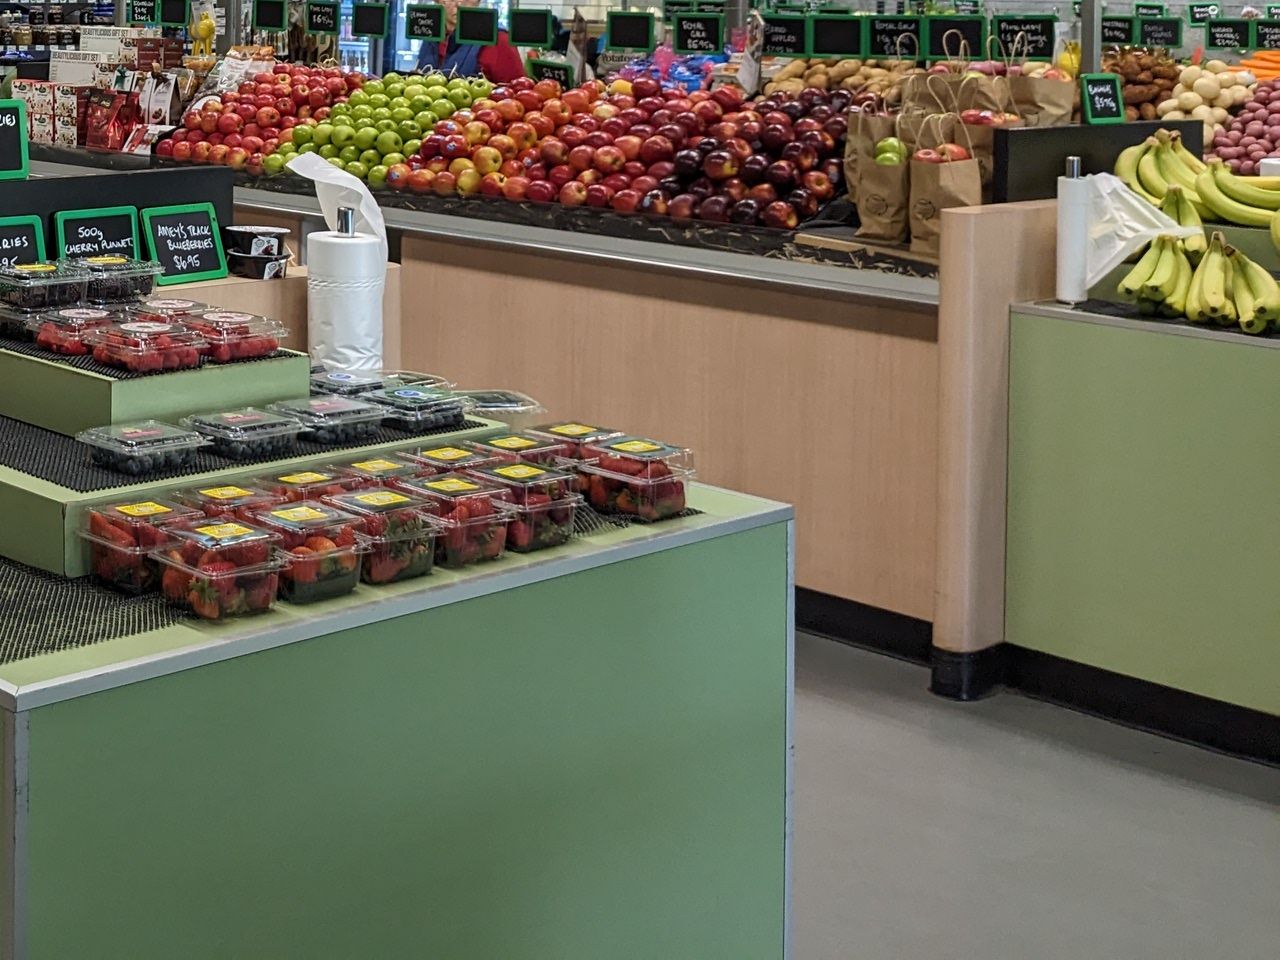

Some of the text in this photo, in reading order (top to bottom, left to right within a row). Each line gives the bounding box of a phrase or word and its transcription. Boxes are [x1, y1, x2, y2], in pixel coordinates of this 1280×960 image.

[78, 226, 104, 240] 500g
[64, 237, 134, 255] CHERRY PUNNET
[166, 238, 214, 250] BLUEBERRIES
[173, 254, 200, 270] $6.95
